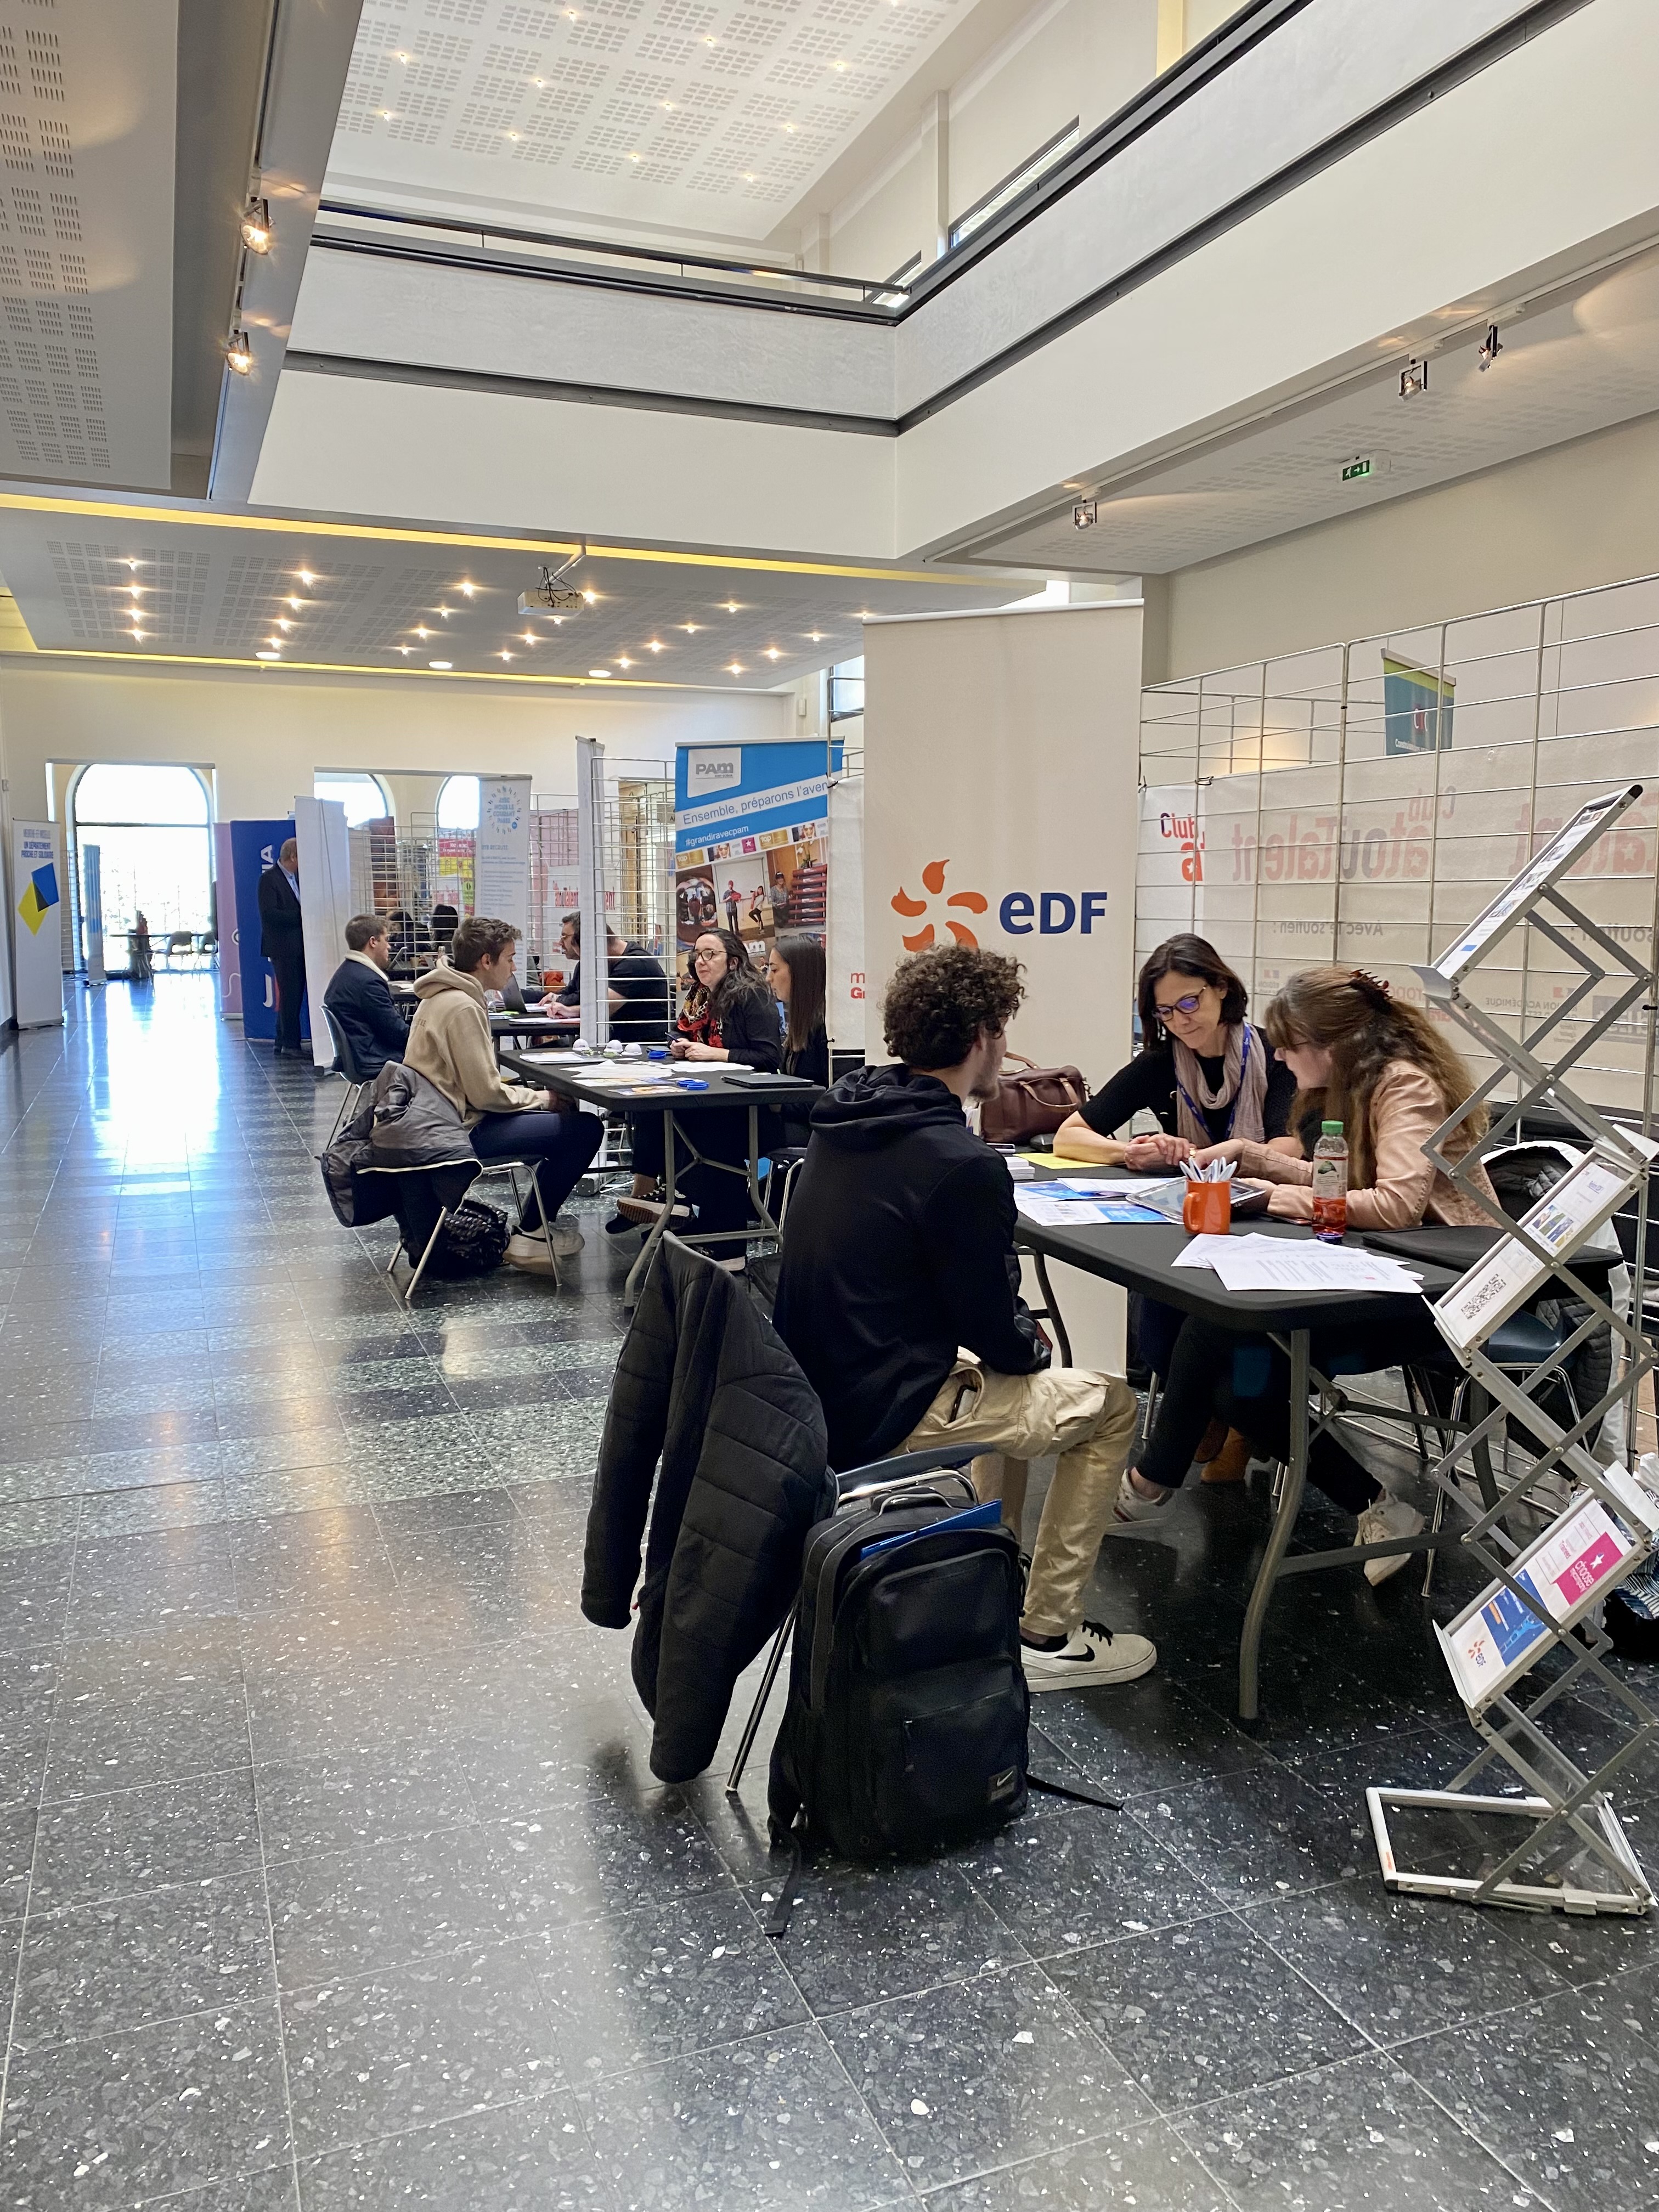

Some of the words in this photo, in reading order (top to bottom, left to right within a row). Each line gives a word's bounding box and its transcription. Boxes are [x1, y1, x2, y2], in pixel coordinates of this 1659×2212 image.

[683, 804, 738, 825] Ensemble,
[741, 791, 794, 813] préparons
[797, 781, 828, 797] l'aven
[685, 825, 749, 847] #grandiravecpam
[1575, 1560, 1594, 1587] choose
